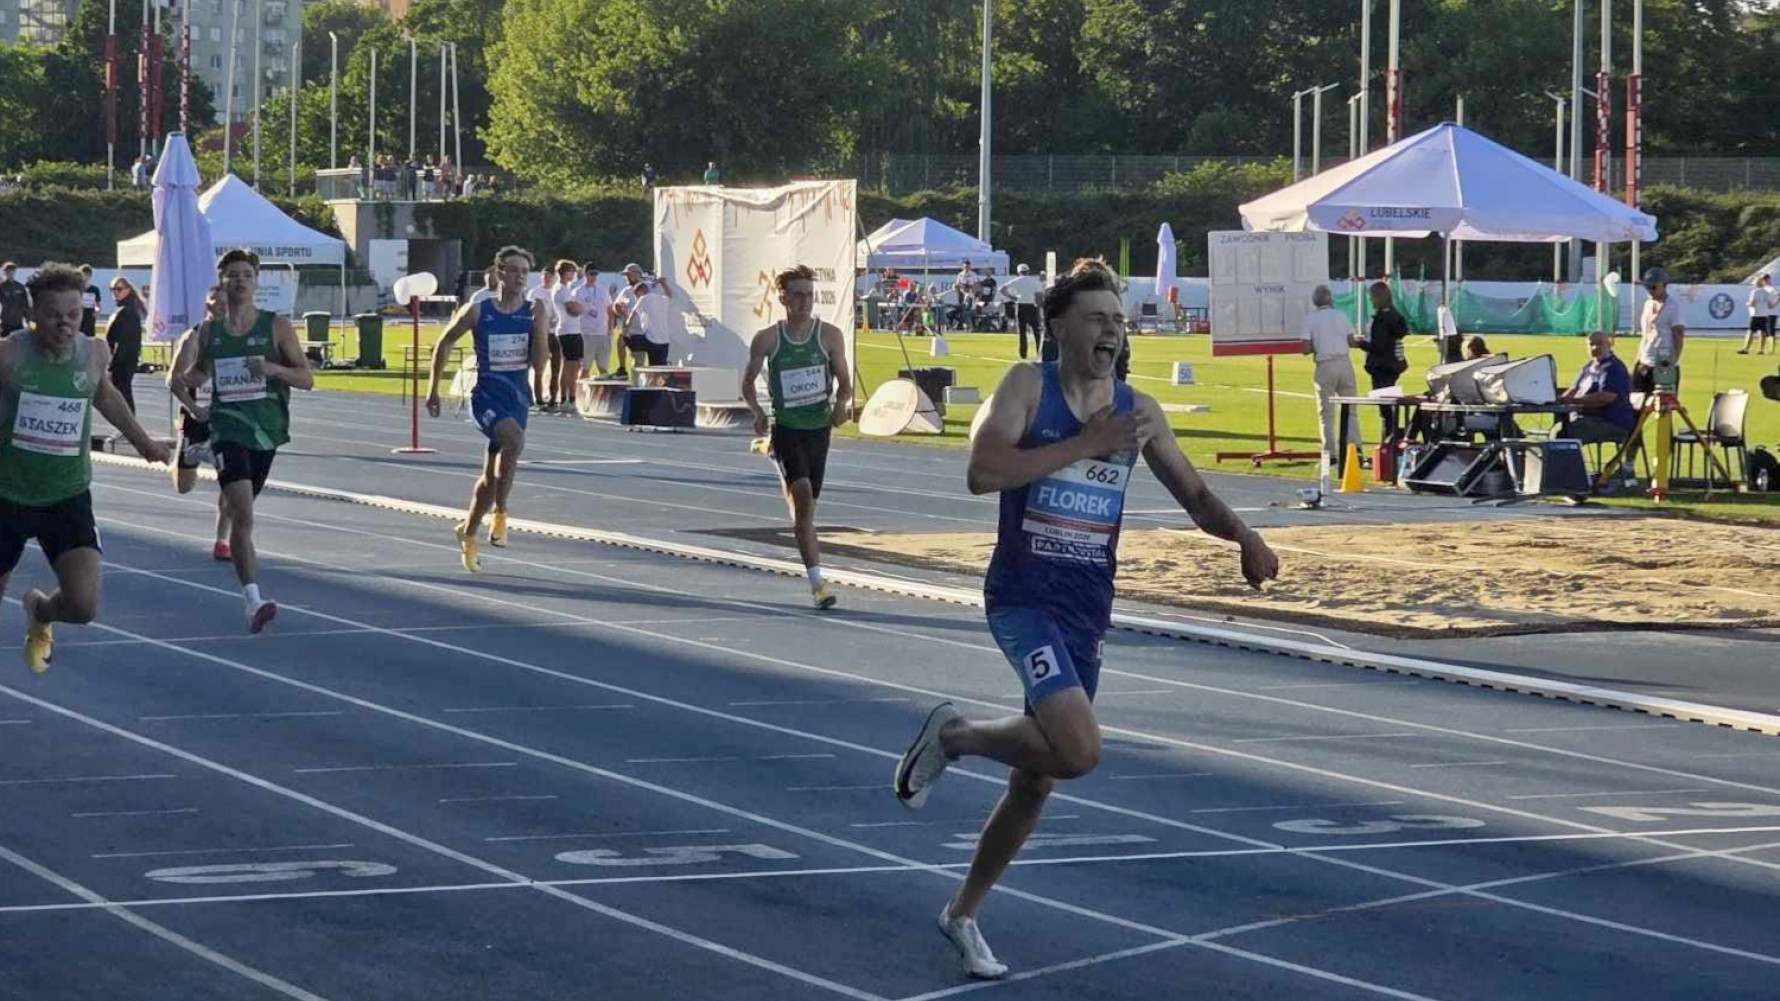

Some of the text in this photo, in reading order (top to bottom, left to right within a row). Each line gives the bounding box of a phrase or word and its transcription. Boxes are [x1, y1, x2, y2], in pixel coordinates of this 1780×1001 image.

[1370, 207, 1432, 219] LUBELSKIE
[275, 247, 312, 257] SPORTU
[1252, 285, 1285, 294] WYNIK
[1180, 366, 1192, 380] 50
[58, 401, 82, 413] 468
[1085, 465, 1120, 485] 662
[1037, 486, 1112, 516] FLOREK
[1030, 650, 1050, 679] 5
[554, 843, 802, 866] 5
